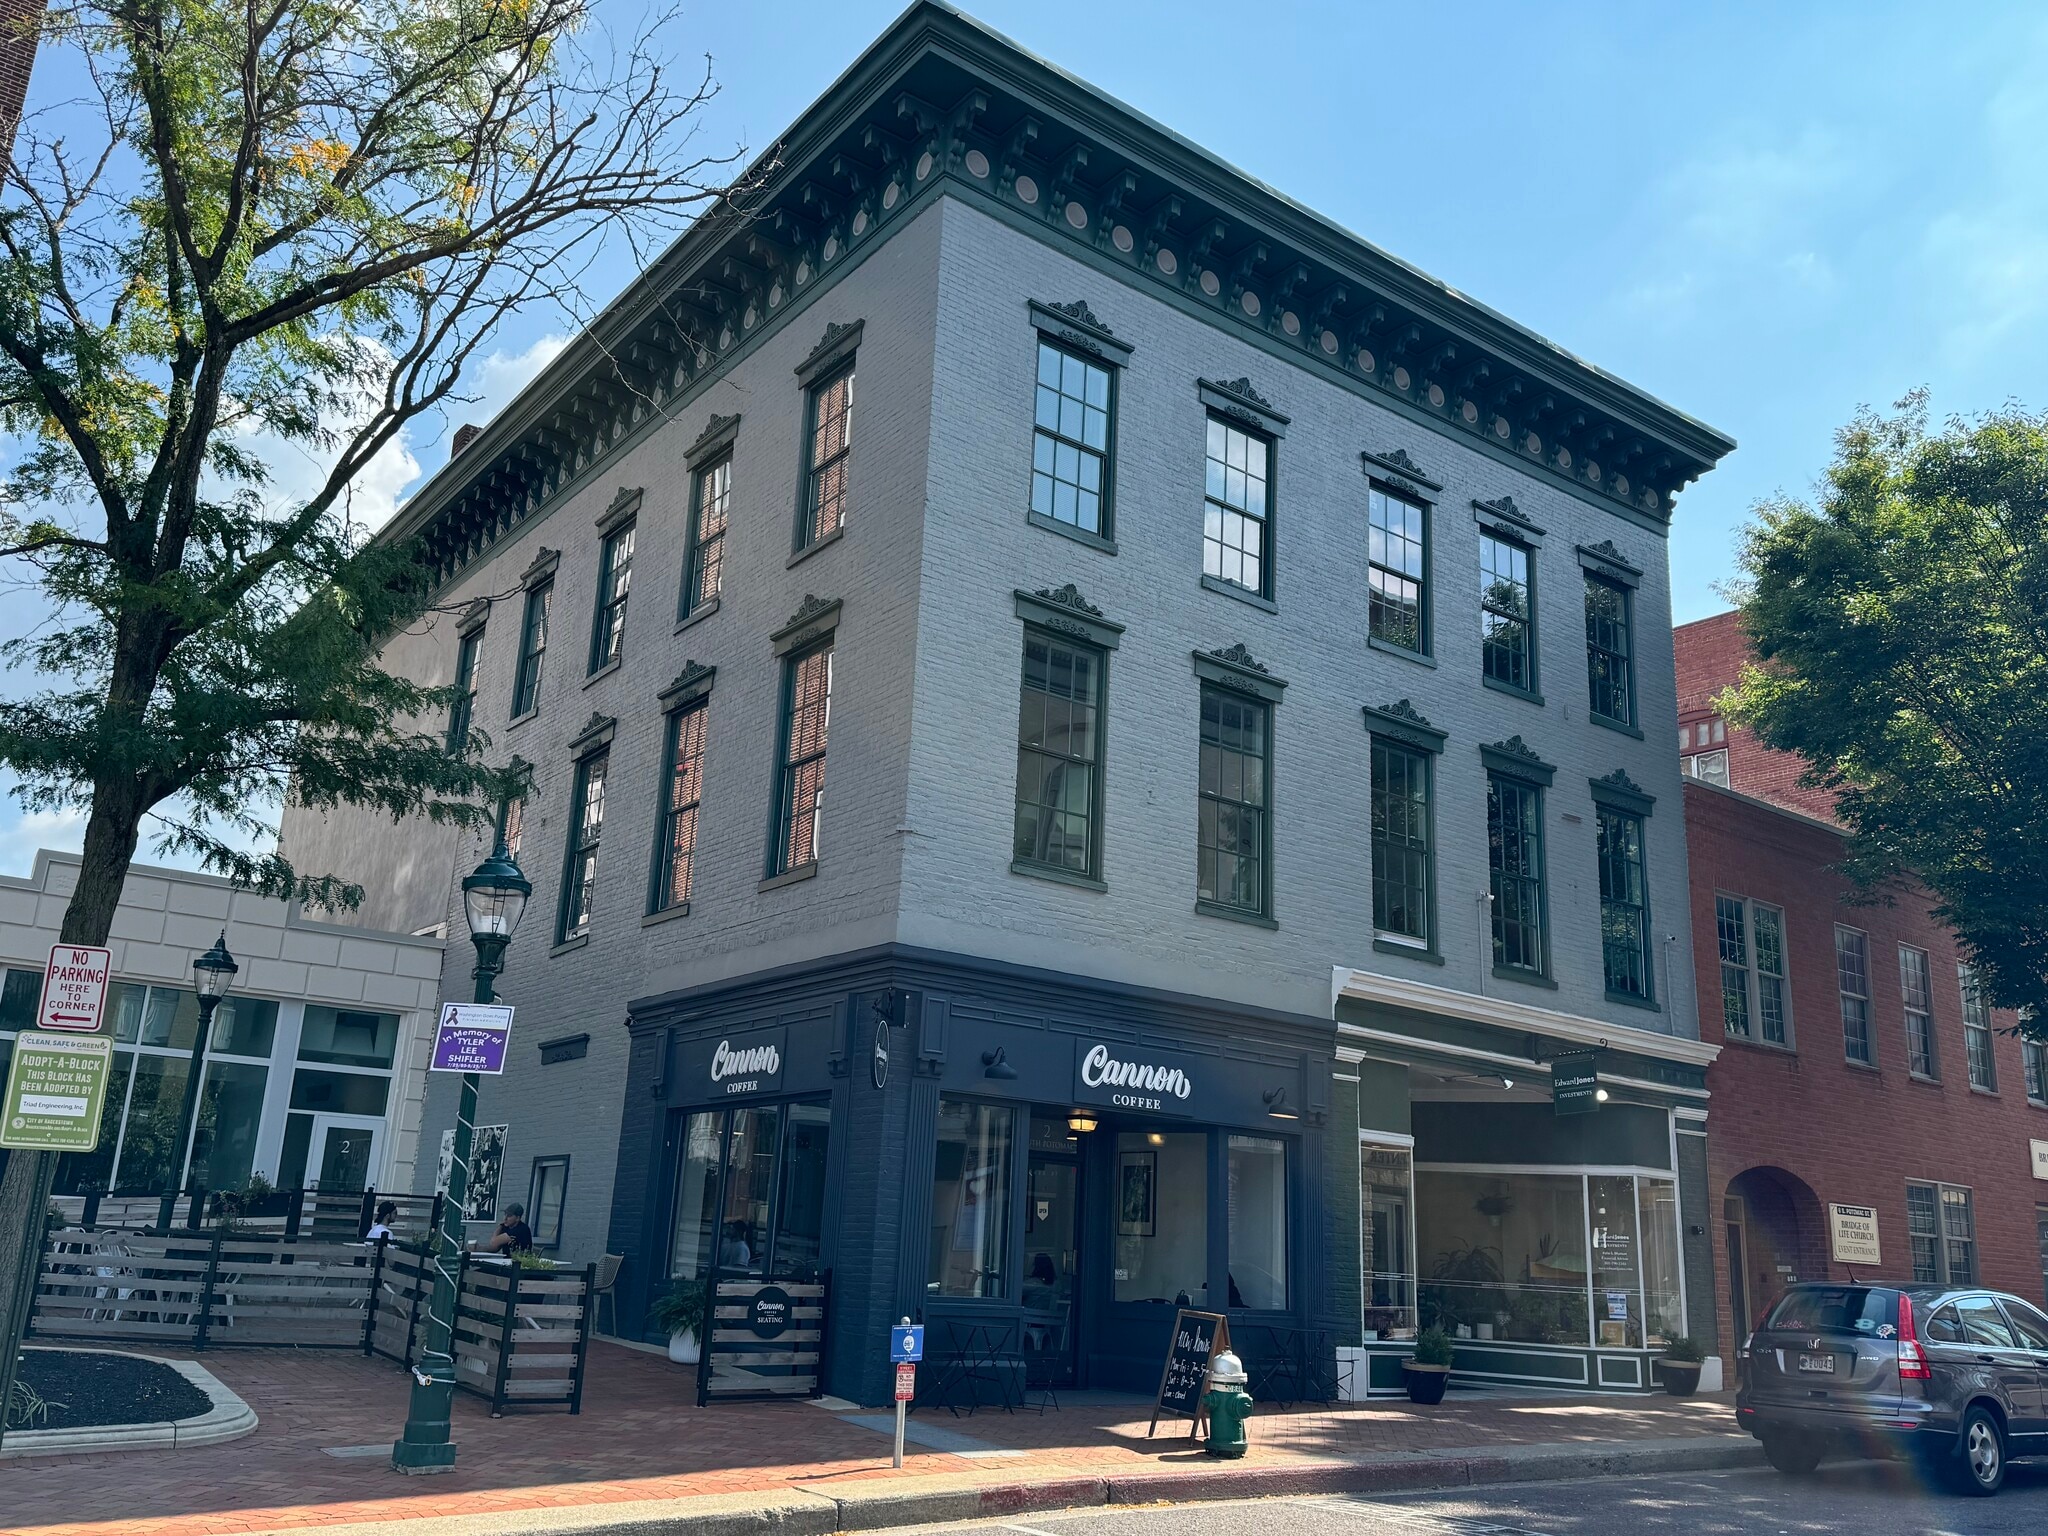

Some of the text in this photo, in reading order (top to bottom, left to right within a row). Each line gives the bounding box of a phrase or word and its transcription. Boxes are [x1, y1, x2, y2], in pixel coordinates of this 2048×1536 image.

[71, 950, 89, 966] NO
[51, 965, 104, 984] PARKING
[60, 983, 91, 993] HERE
[67, 993, 81, 1001] TO
[48, 1000, 96, 1011] CORNER
[26, 1038, 52, 1046] CLEAN,
[53, 1039, 70, 1047] SAFE
[442, 1030, 503, 1045] In Memory of
[457, 1037, 485, 1046] TYLER
[460, 1046, 478, 1055] LEE
[21, 1054, 101, 1071] ADOPT-A-BLOCK
[447, 1054, 487, 1064] SHIFLER
[711, 1040, 779, 1082] Cannon
[27, 1069, 92, 1083] THIS BLOCK HAS
[1081, 1044, 1191, 1100] Cannon
[20, 1081, 93, 1095] BEEN ADOPTED BY
[727, 1081, 758, 1093] COFFEE
[1559, 1090, 1593, 1099] INVESTMENTS
[1112, 1094, 1161, 1110] COFFEE
[1043, 1125, 1051, 1138] 2
[341, 1140, 350, 1153] 2
[1841, 1220, 1870, 1231] BRIDGE OF
[1838, 1230, 1874, 1241] LIFE CHURCH
[1838, 1245, 1877, 1256] EVENT ENTRANCE
[757, 1300, 785, 1311] Cannon
